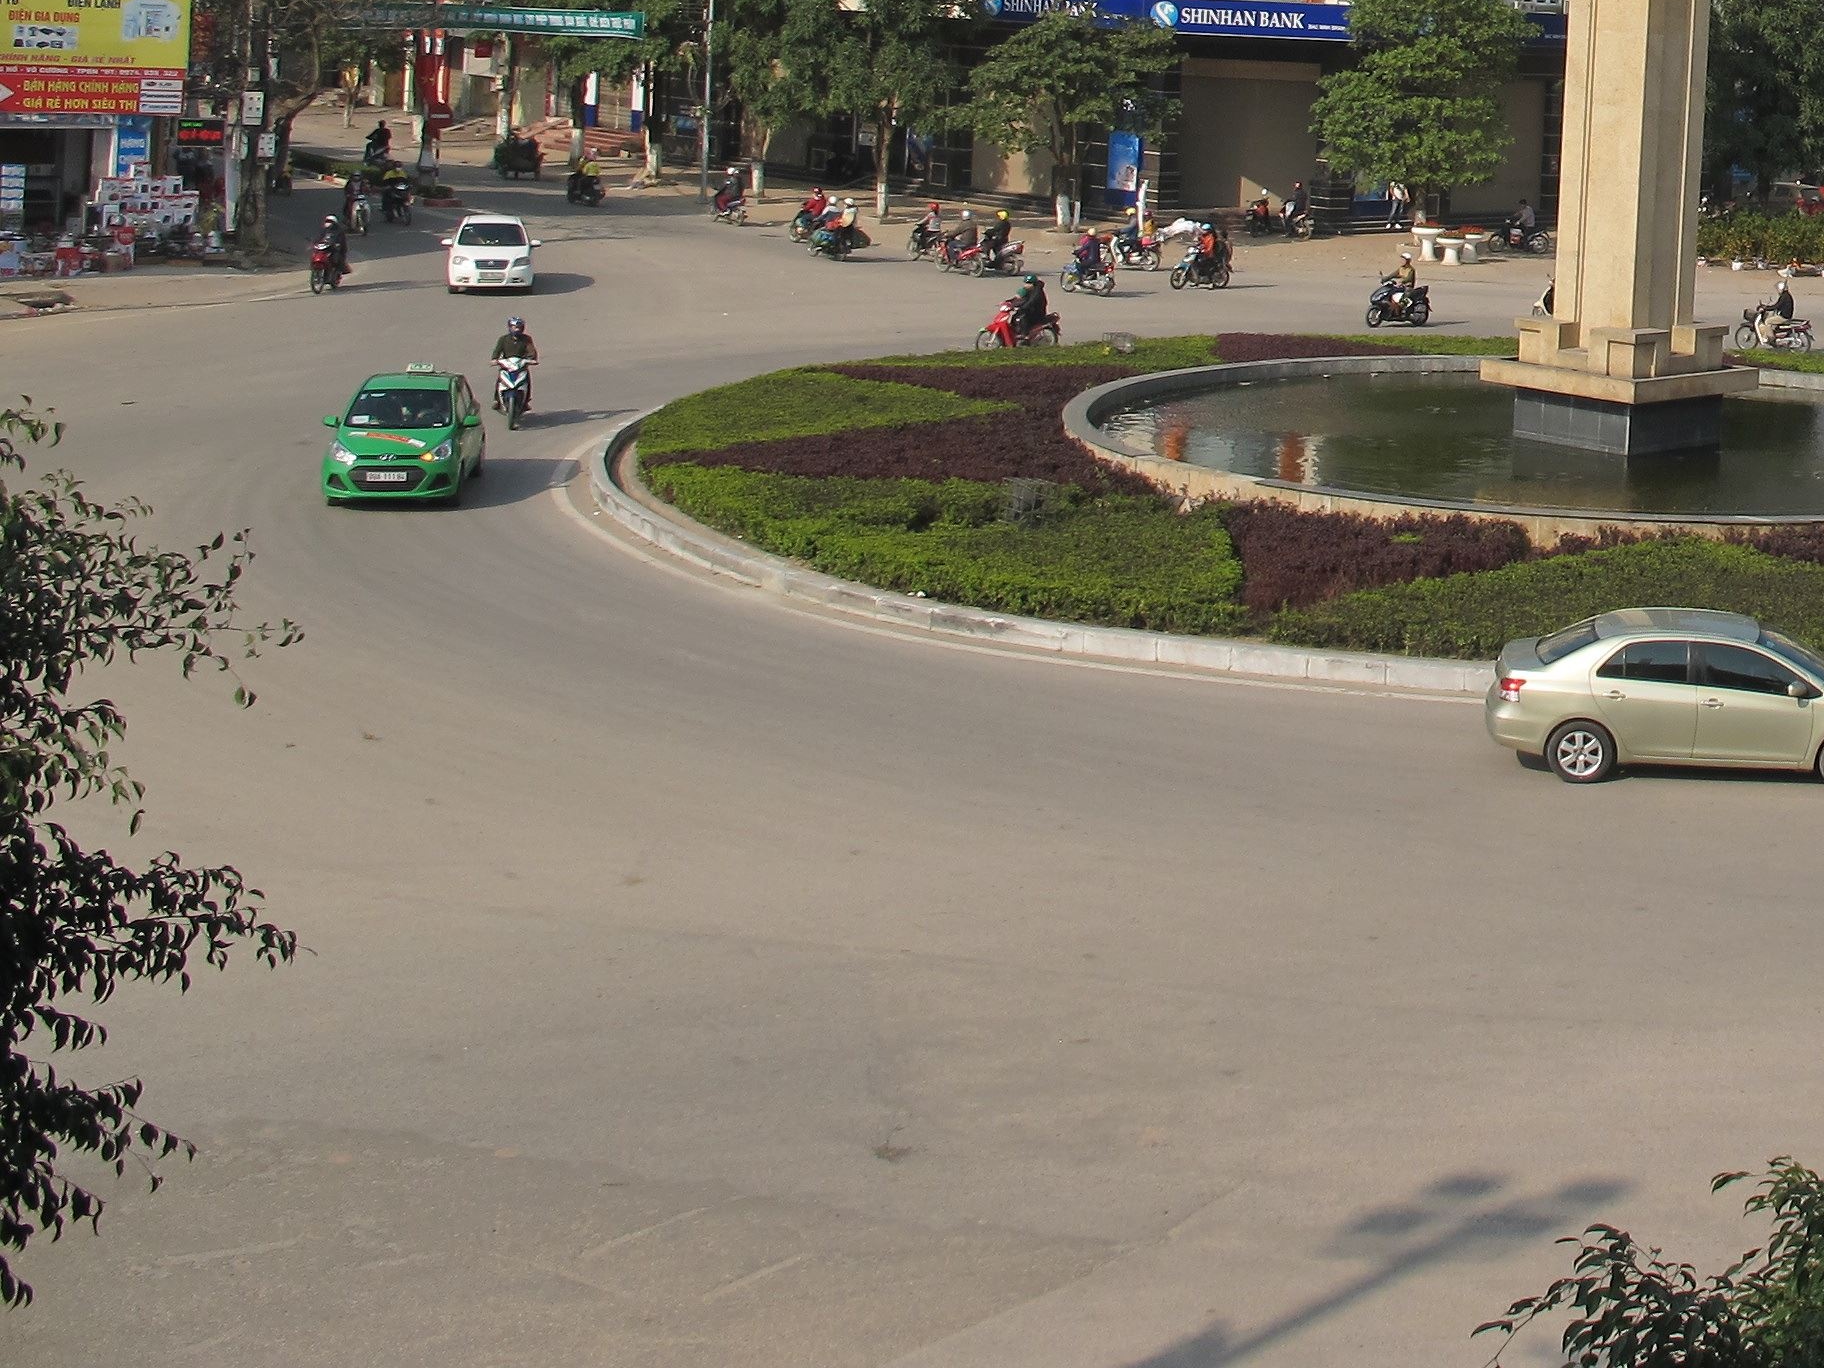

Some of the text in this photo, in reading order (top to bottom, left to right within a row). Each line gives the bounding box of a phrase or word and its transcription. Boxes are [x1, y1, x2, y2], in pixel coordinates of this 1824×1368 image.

[8, 9, 80, 26] ĐIỆN GIA DỤNG
[1180, 7, 1256, 29] SHINHAN
[1259, 11, 1305, 30] BANK
[23, 79, 45, 92] BÁN
[79, 79, 109, 93] CHÍNH
[23, 97, 43, 108] GIÁ
[46, 97, 61, 109] RẺ
[64, 99, 88, 110] HƠN
[92, 98, 117, 110] SIÊU
[120, 100, 138, 112] THỊ
